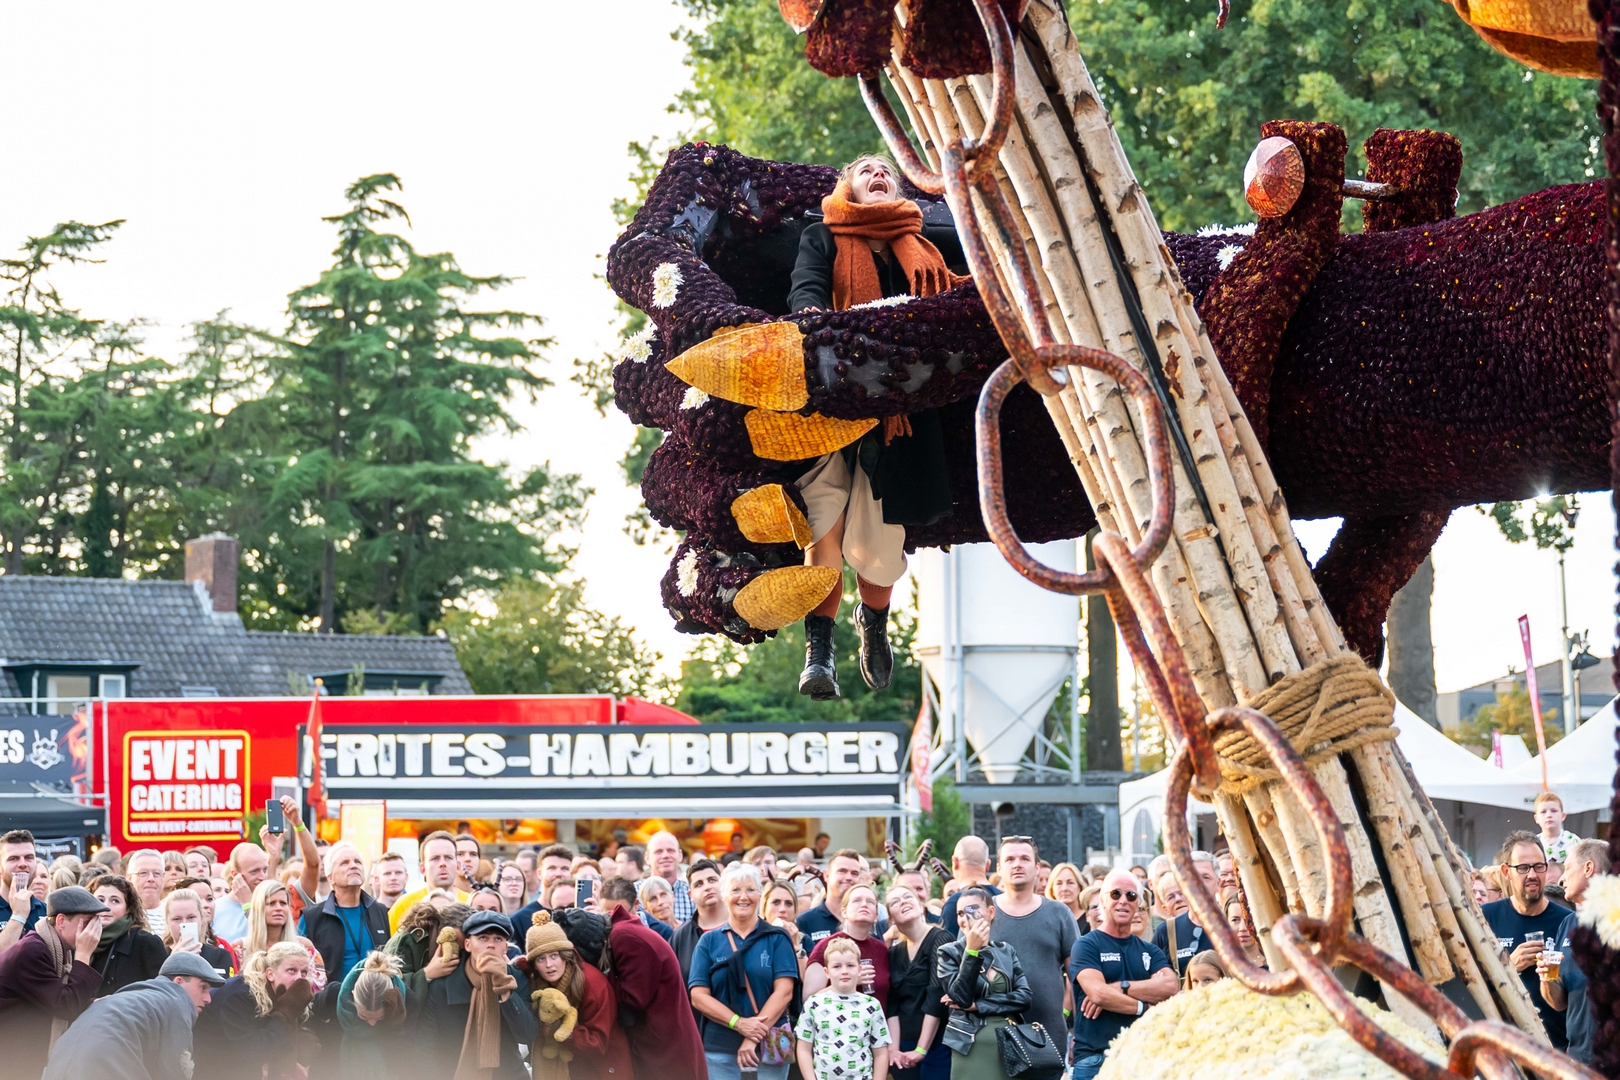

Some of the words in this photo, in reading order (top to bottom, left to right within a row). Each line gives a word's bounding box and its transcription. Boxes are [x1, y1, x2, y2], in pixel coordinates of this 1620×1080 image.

[131, 739, 243, 780] EVENT
[303, 731, 899, 776] FRITES-HAMBURGER
[130, 783, 242, 811] CATERING
